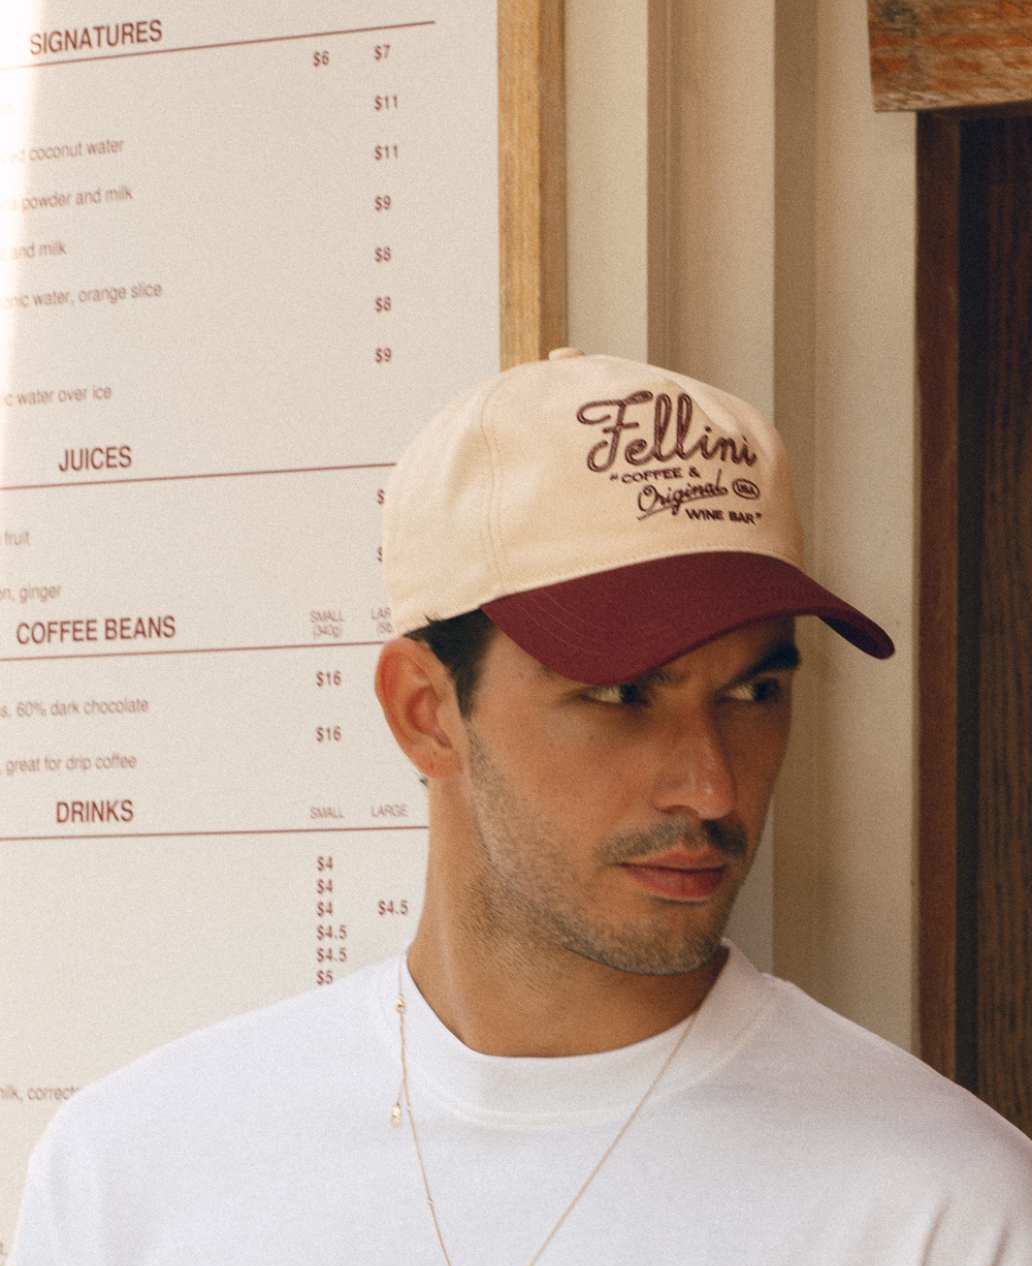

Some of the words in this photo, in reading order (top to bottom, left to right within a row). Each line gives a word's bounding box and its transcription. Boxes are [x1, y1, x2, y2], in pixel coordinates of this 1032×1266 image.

[30, 19, 163, 55] SIGNATURES
[313, 50, 330, 67] $6
[375, 44, 391, 60] $7
[375, 96, 398, 111] $11
[29, 142, 82, 161] coconut
[86, 139, 124, 155] water
[375, 145, 398, 160] $11
[23, 191, 71, 211] powder
[75, 189, 101, 205] and
[105, 185, 134, 203] milk
[39, 240, 66, 256] milk
[78, 286, 126, 304] orange
[131, 282, 162, 298] slice
[17, 389, 54, 405] water
[58, 387, 88, 402] over
[92, 384, 112, 400] ice
[577, 390, 758, 472] Fellini
[58, 445, 132, 472] JUICES
[637, 469, 729, 518] Original
[686, 508, 724, 521] WINE
[4, 530, 31, 546] fruit
[19, 583, 62, 604] ginger
[310, 610, 345, 623] SMALL
[16, 620, 98, 645] COFFEE
[104, 615, 176, 640] BEANS
[316, 671, 342, 687] $16
[16, 701, 48, 718] 60%
[50, 701, 81, 717] dark
[83, 697, 149, 715] chocolate
[316, 726, 342, 742] $16
[6, 756, 40, 776] great
[44, 755, 63, 772] for
[65, 755, 92, 772] drip
[95, 753, 138, 770] coffee
[56, 799, 134, 823] DRINKS
[310, 806, 344, 819] SMALL
[371, 804, 409, 818] LARGE
[316, 856, 333, 871] $4
[316, 879, 333, 894] $4
[316, 901, 333, 917] $4
[378, 900, 408, 916] $4.5
[316, 924, 347, 940] $4.5
[316, 947, 347, 962] $4.5
[316, 970, 333, 986] $5
